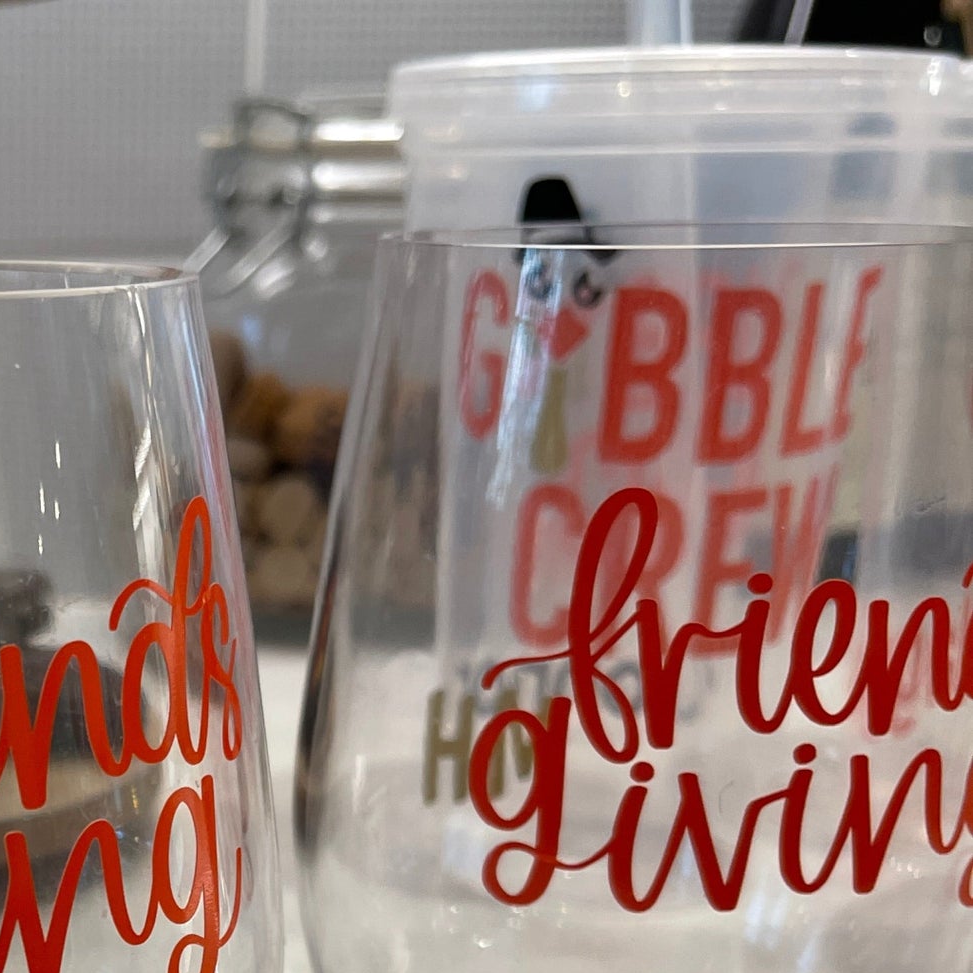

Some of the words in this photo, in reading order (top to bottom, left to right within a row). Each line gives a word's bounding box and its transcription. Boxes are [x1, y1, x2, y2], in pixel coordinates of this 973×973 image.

[458, 266, 885, 467] GBBLE
[480, 487, 973, 763] frien
[468, 697, 973, 913] givin
